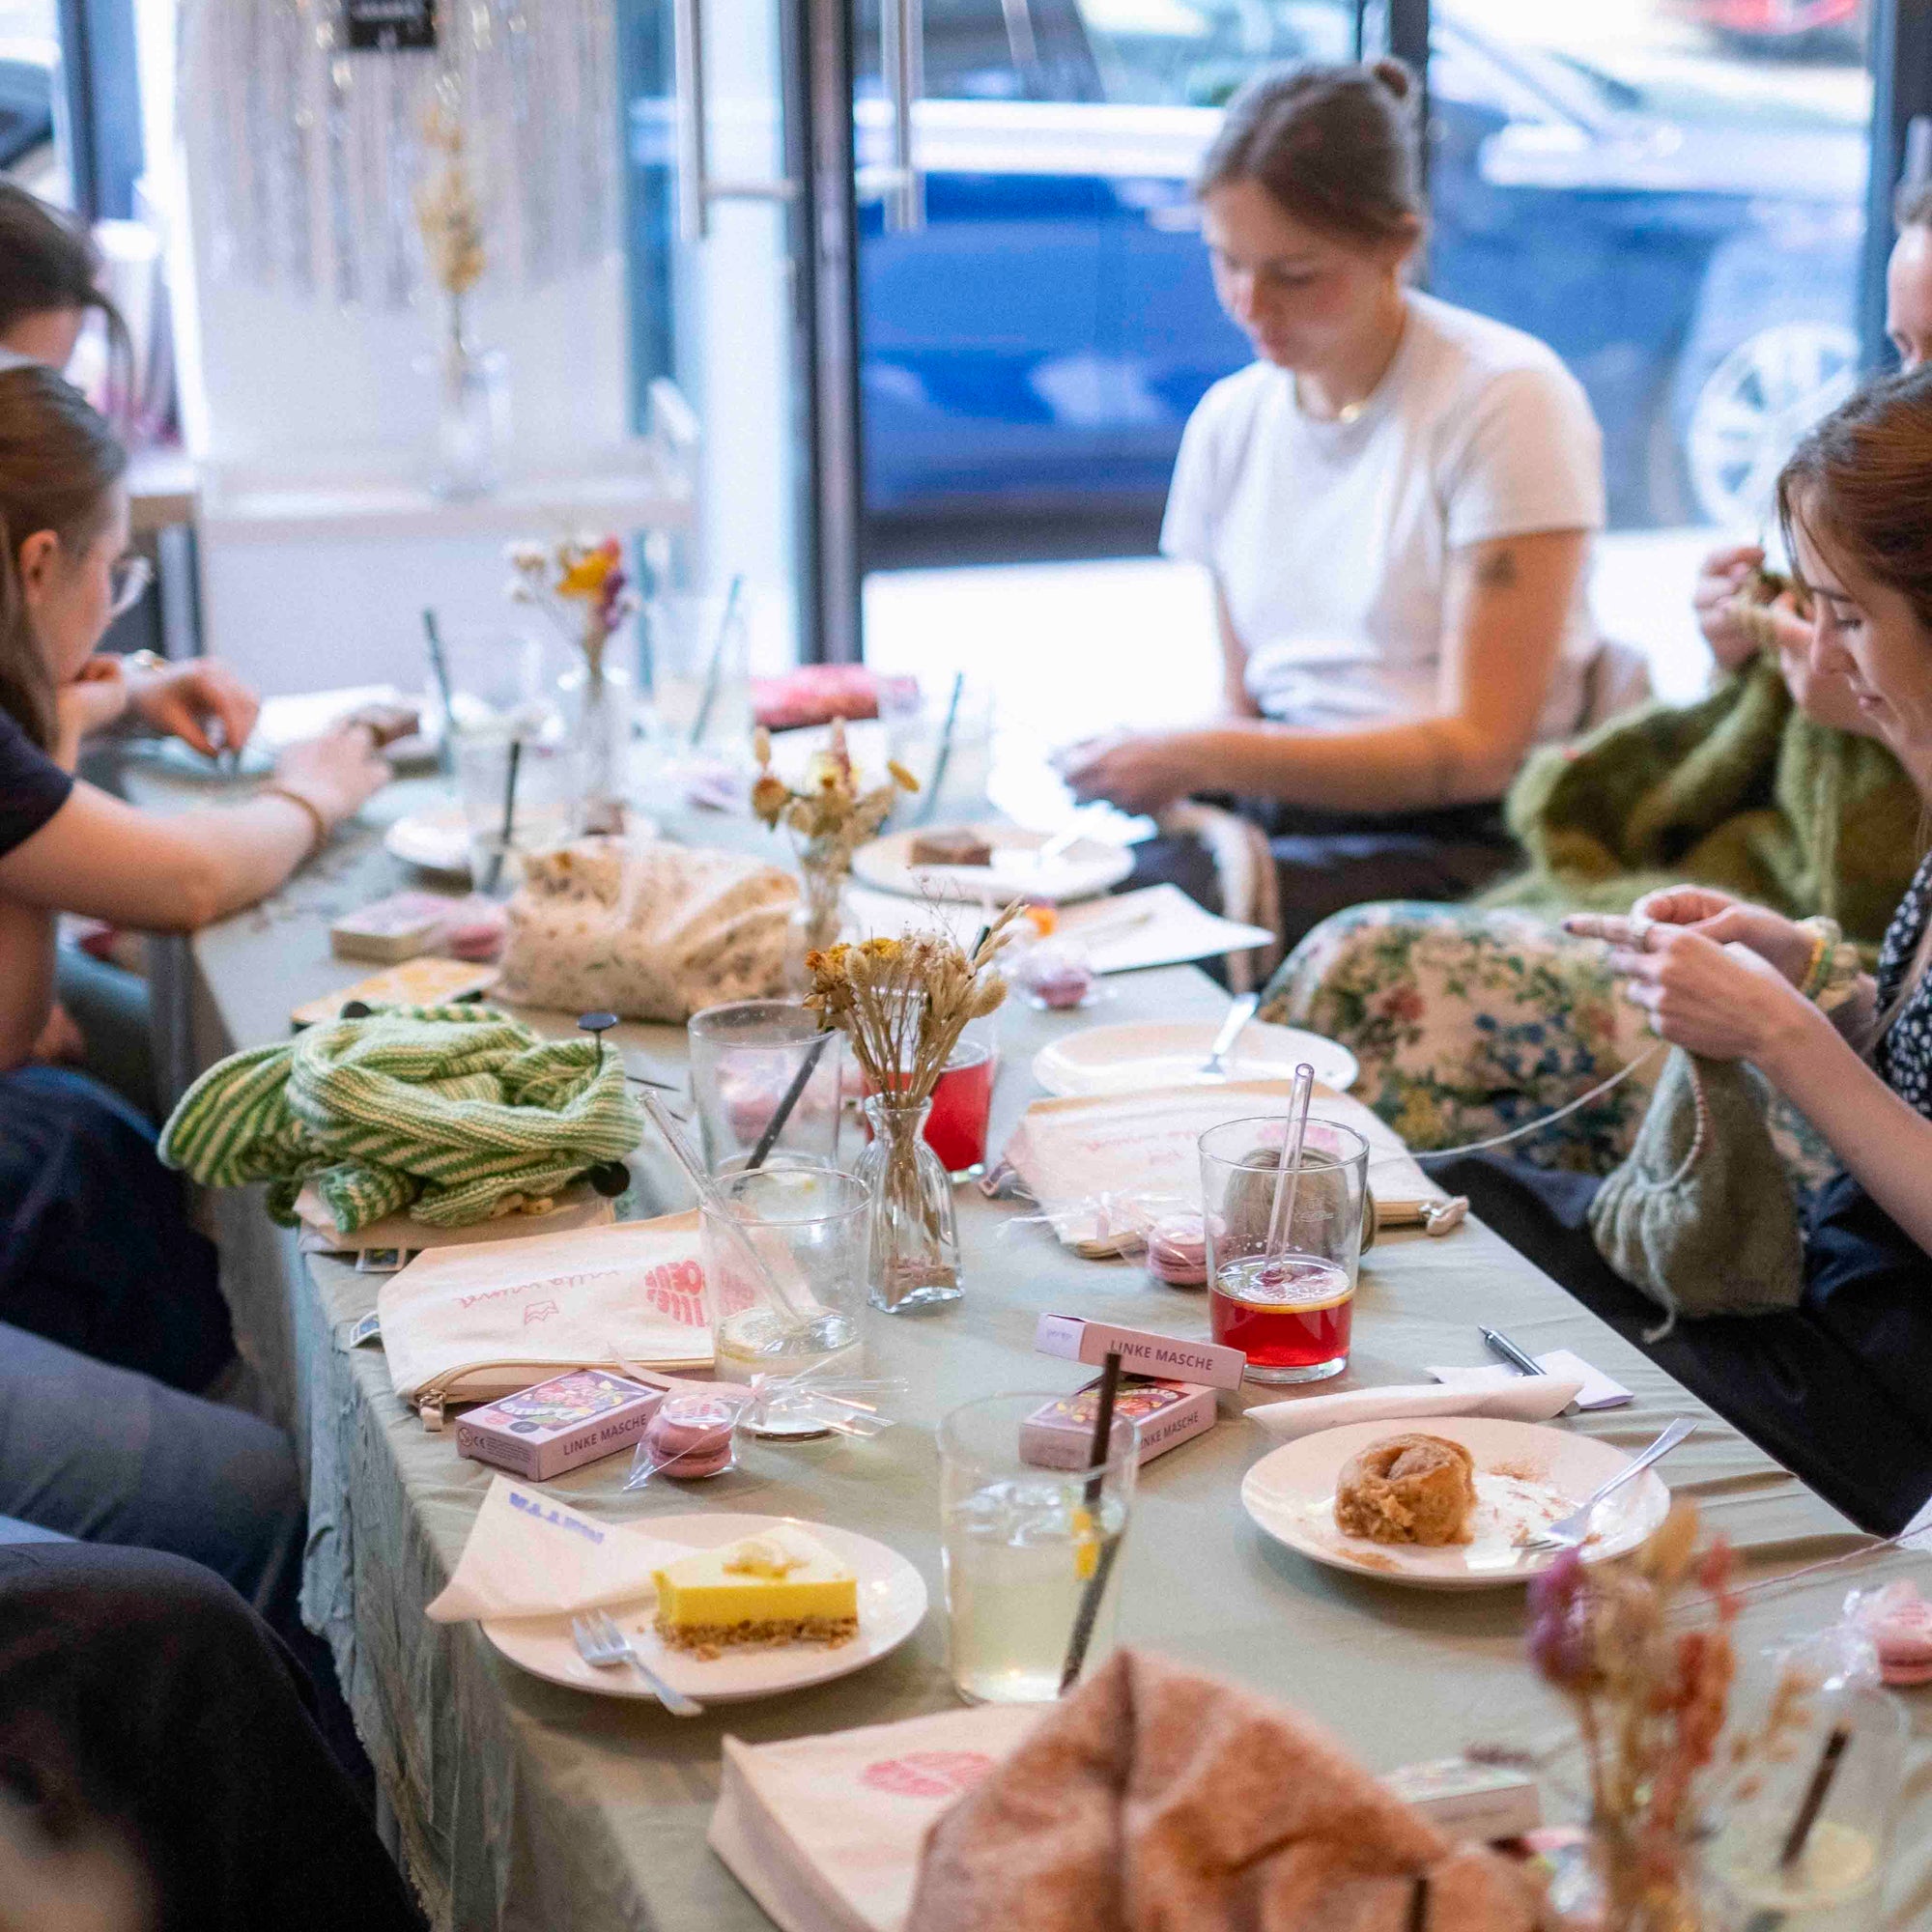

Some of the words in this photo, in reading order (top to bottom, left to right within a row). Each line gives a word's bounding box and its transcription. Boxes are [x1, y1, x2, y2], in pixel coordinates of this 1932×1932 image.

[1110, 1340, 1152, 1359] LINKE
[1155, 1350, 1213, 1371] MASCHE
[563, 1433, 598, 1456] LINKE
[600, 1413, 647, 1442] MASCHE
[1140, 1430, 1162, 1449] INKE
[1164, 1411, 1199, 1437] MASCHE
